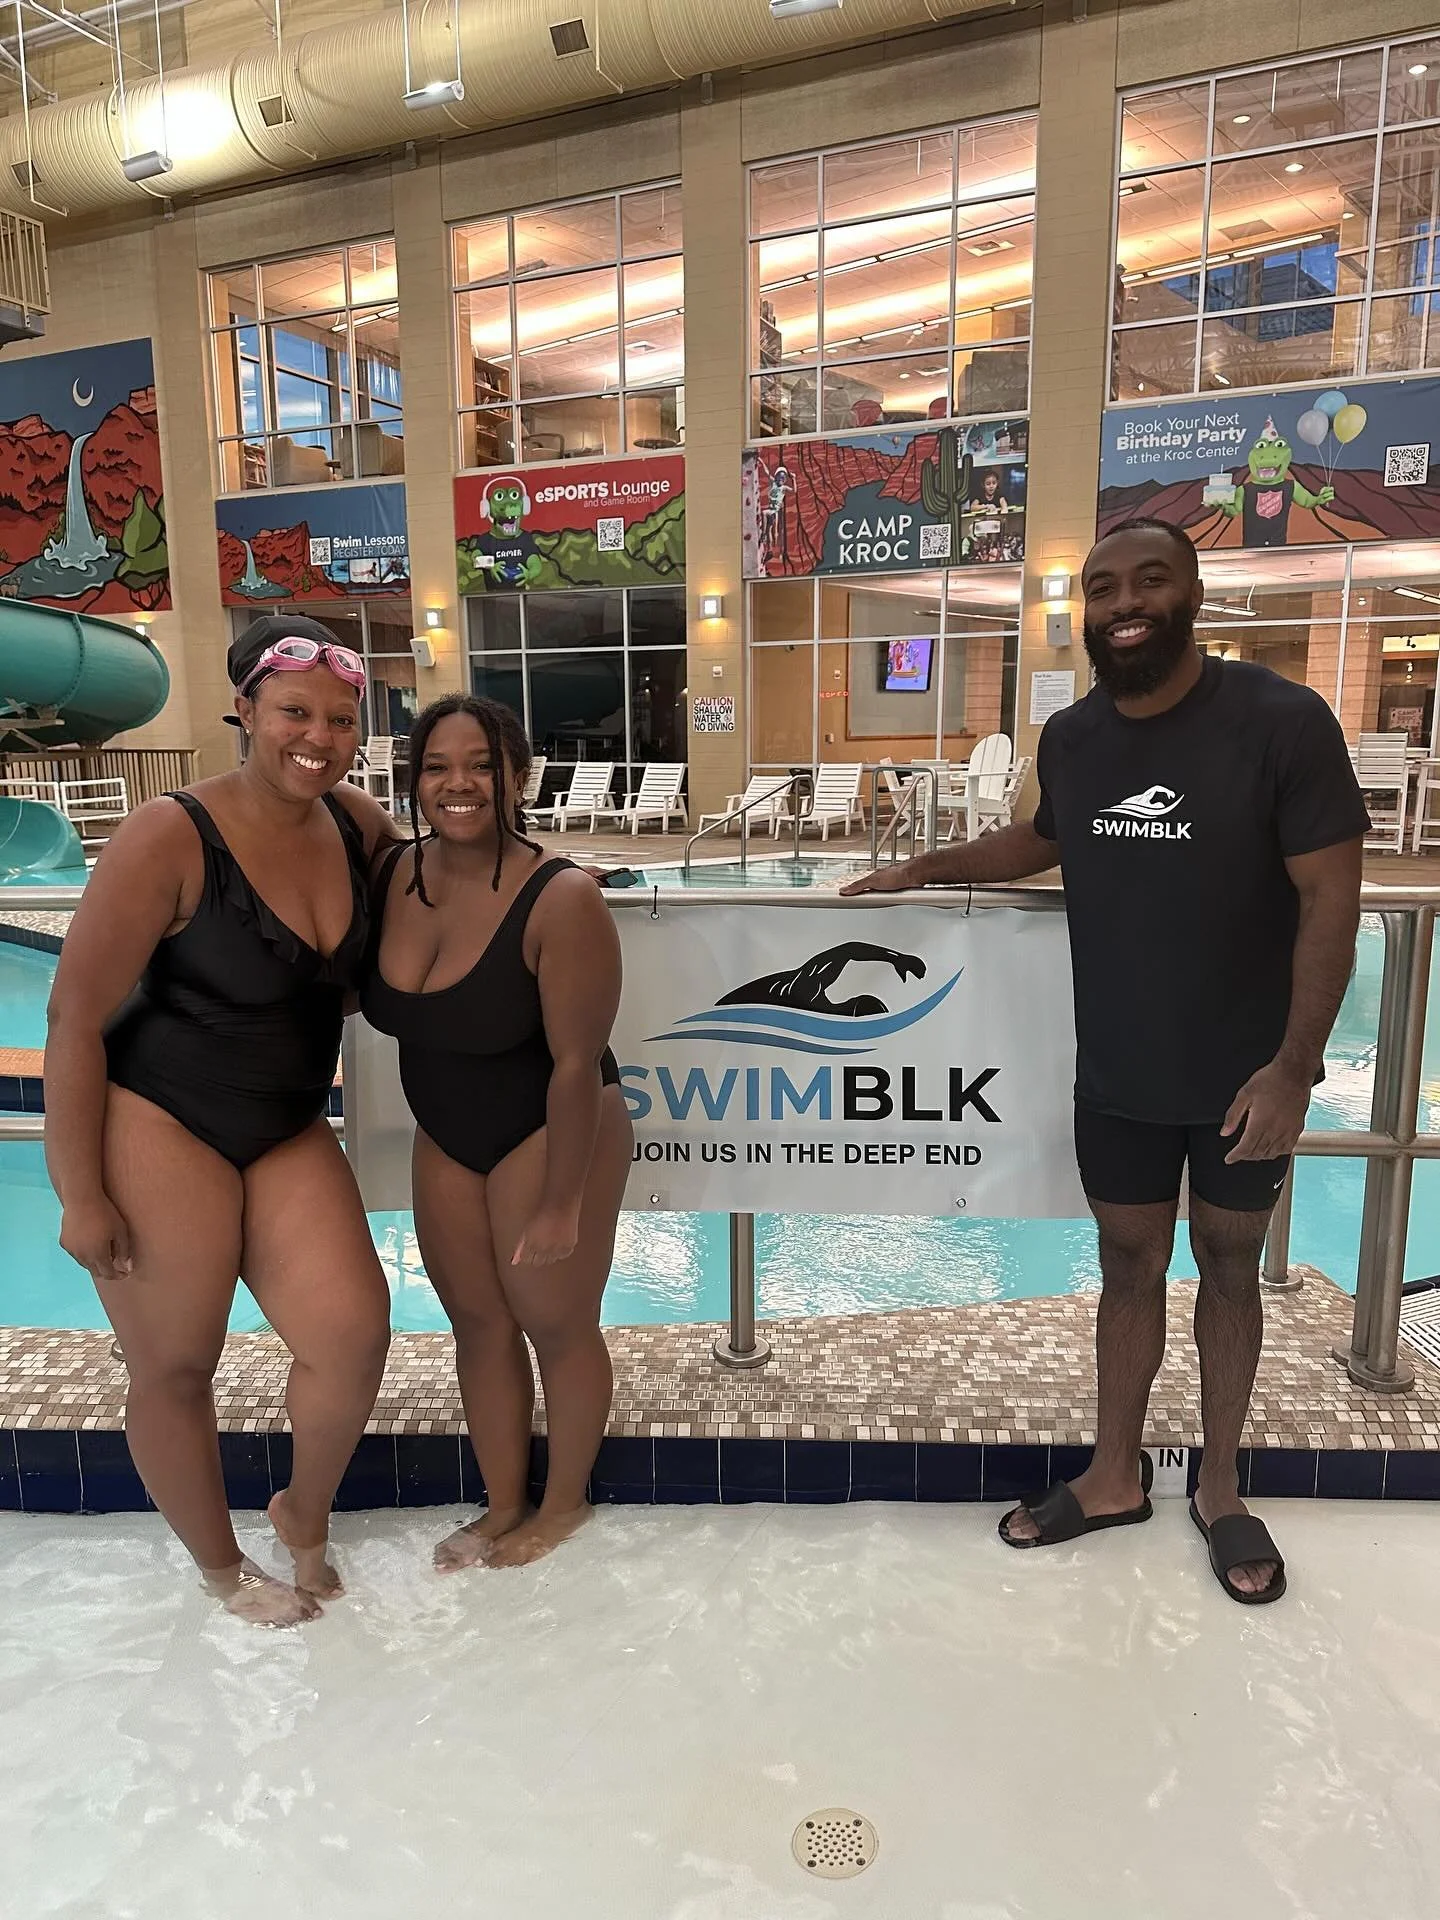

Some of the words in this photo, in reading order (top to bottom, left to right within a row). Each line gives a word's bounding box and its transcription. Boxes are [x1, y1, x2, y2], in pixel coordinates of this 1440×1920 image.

[1125, 420, 1162, 435] Book
[1167, 417, 1200, 430] Your
[1204, 412, 1240, 427] Next
[1116, 432, 1193, 450] Birthday
[1197, 427, 1247, 443] Party
[1126, 454, 1138, 465] at
[1141, 451, 1160, 463] the
[1164, 448, 1193, 461] Kroc
[1196, 446, 1240, 458] Center
[535, 482, 609, 503] eSPORTS
[612, 480, 671, 497] Lounge
[583, 500, 599, 508] and
[600, 497, 625, 506] Game
[626, 495, 651, 504] Room
[838, 514, 912, 540] CAMP
[333, 535, 362, 548] Swim
[364, 535, 406, 546] Lessons
[333, 546, 374, 557] REGISTER
[375, 545, 406, 555] TODAY
[839, 539, 910, 565] KROC
[693, 697, 733, 706] CAUTION
[693, 705, 733, 714] SHALLOW
[694, 714, 721, 722] WATER
[694, 722, 706, 731] NO
[707, 722, 734, 731] DIVING
[1092, 818, 1192, 840] SWIMBLK
[618, 1065, 1003, 1123] SWIMBLK
[632, 1142, 690, 1162] JOIN
[701, 1143, 736, 1163] US
[747, 1144, 772, 1163] IN
[781, 1144, 834, 1164] THE
[844, 1144, 916, 1165] DEEP
[925, 1145, 982, 1166] END
[1159, 1449, 1183, 1467] IN
